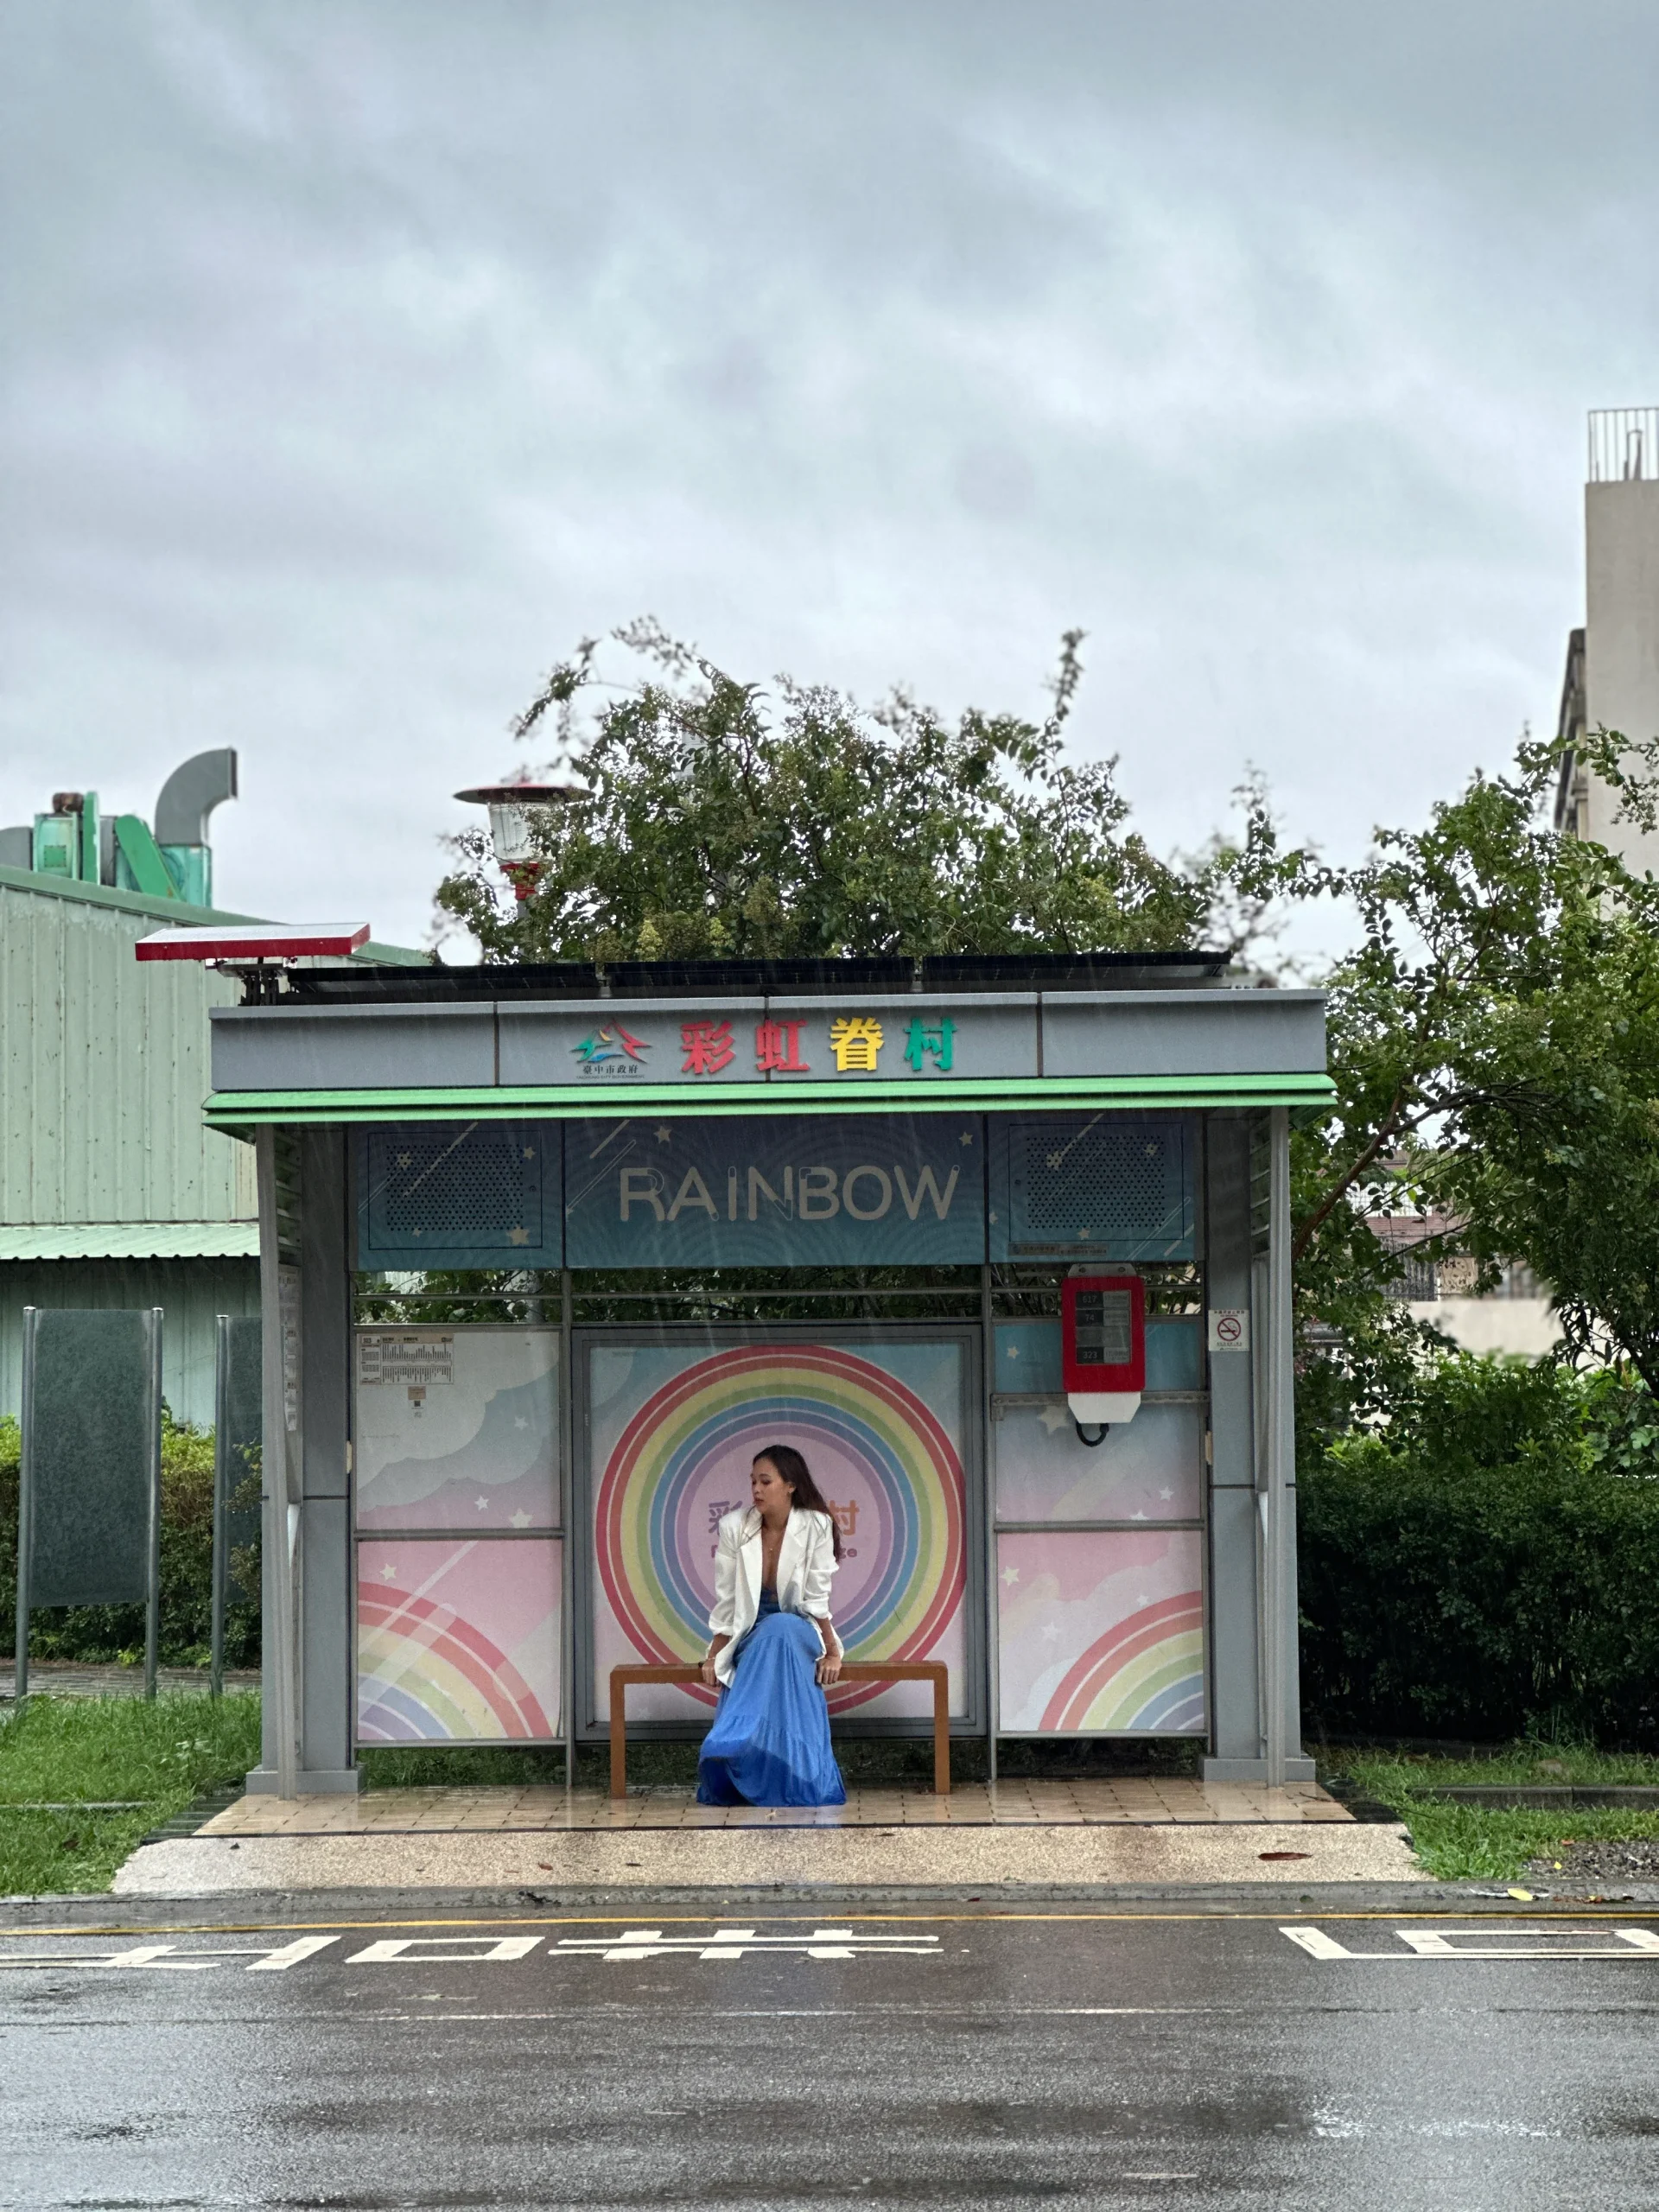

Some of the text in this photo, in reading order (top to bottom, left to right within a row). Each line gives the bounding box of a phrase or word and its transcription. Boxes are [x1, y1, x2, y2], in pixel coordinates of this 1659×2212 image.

[583, 1064, 638, 1074] 臺中市政府
[680, 1016, 957, 1074] 彩虹眷村
[619, 1165, 960, 1222] RAINBOW
